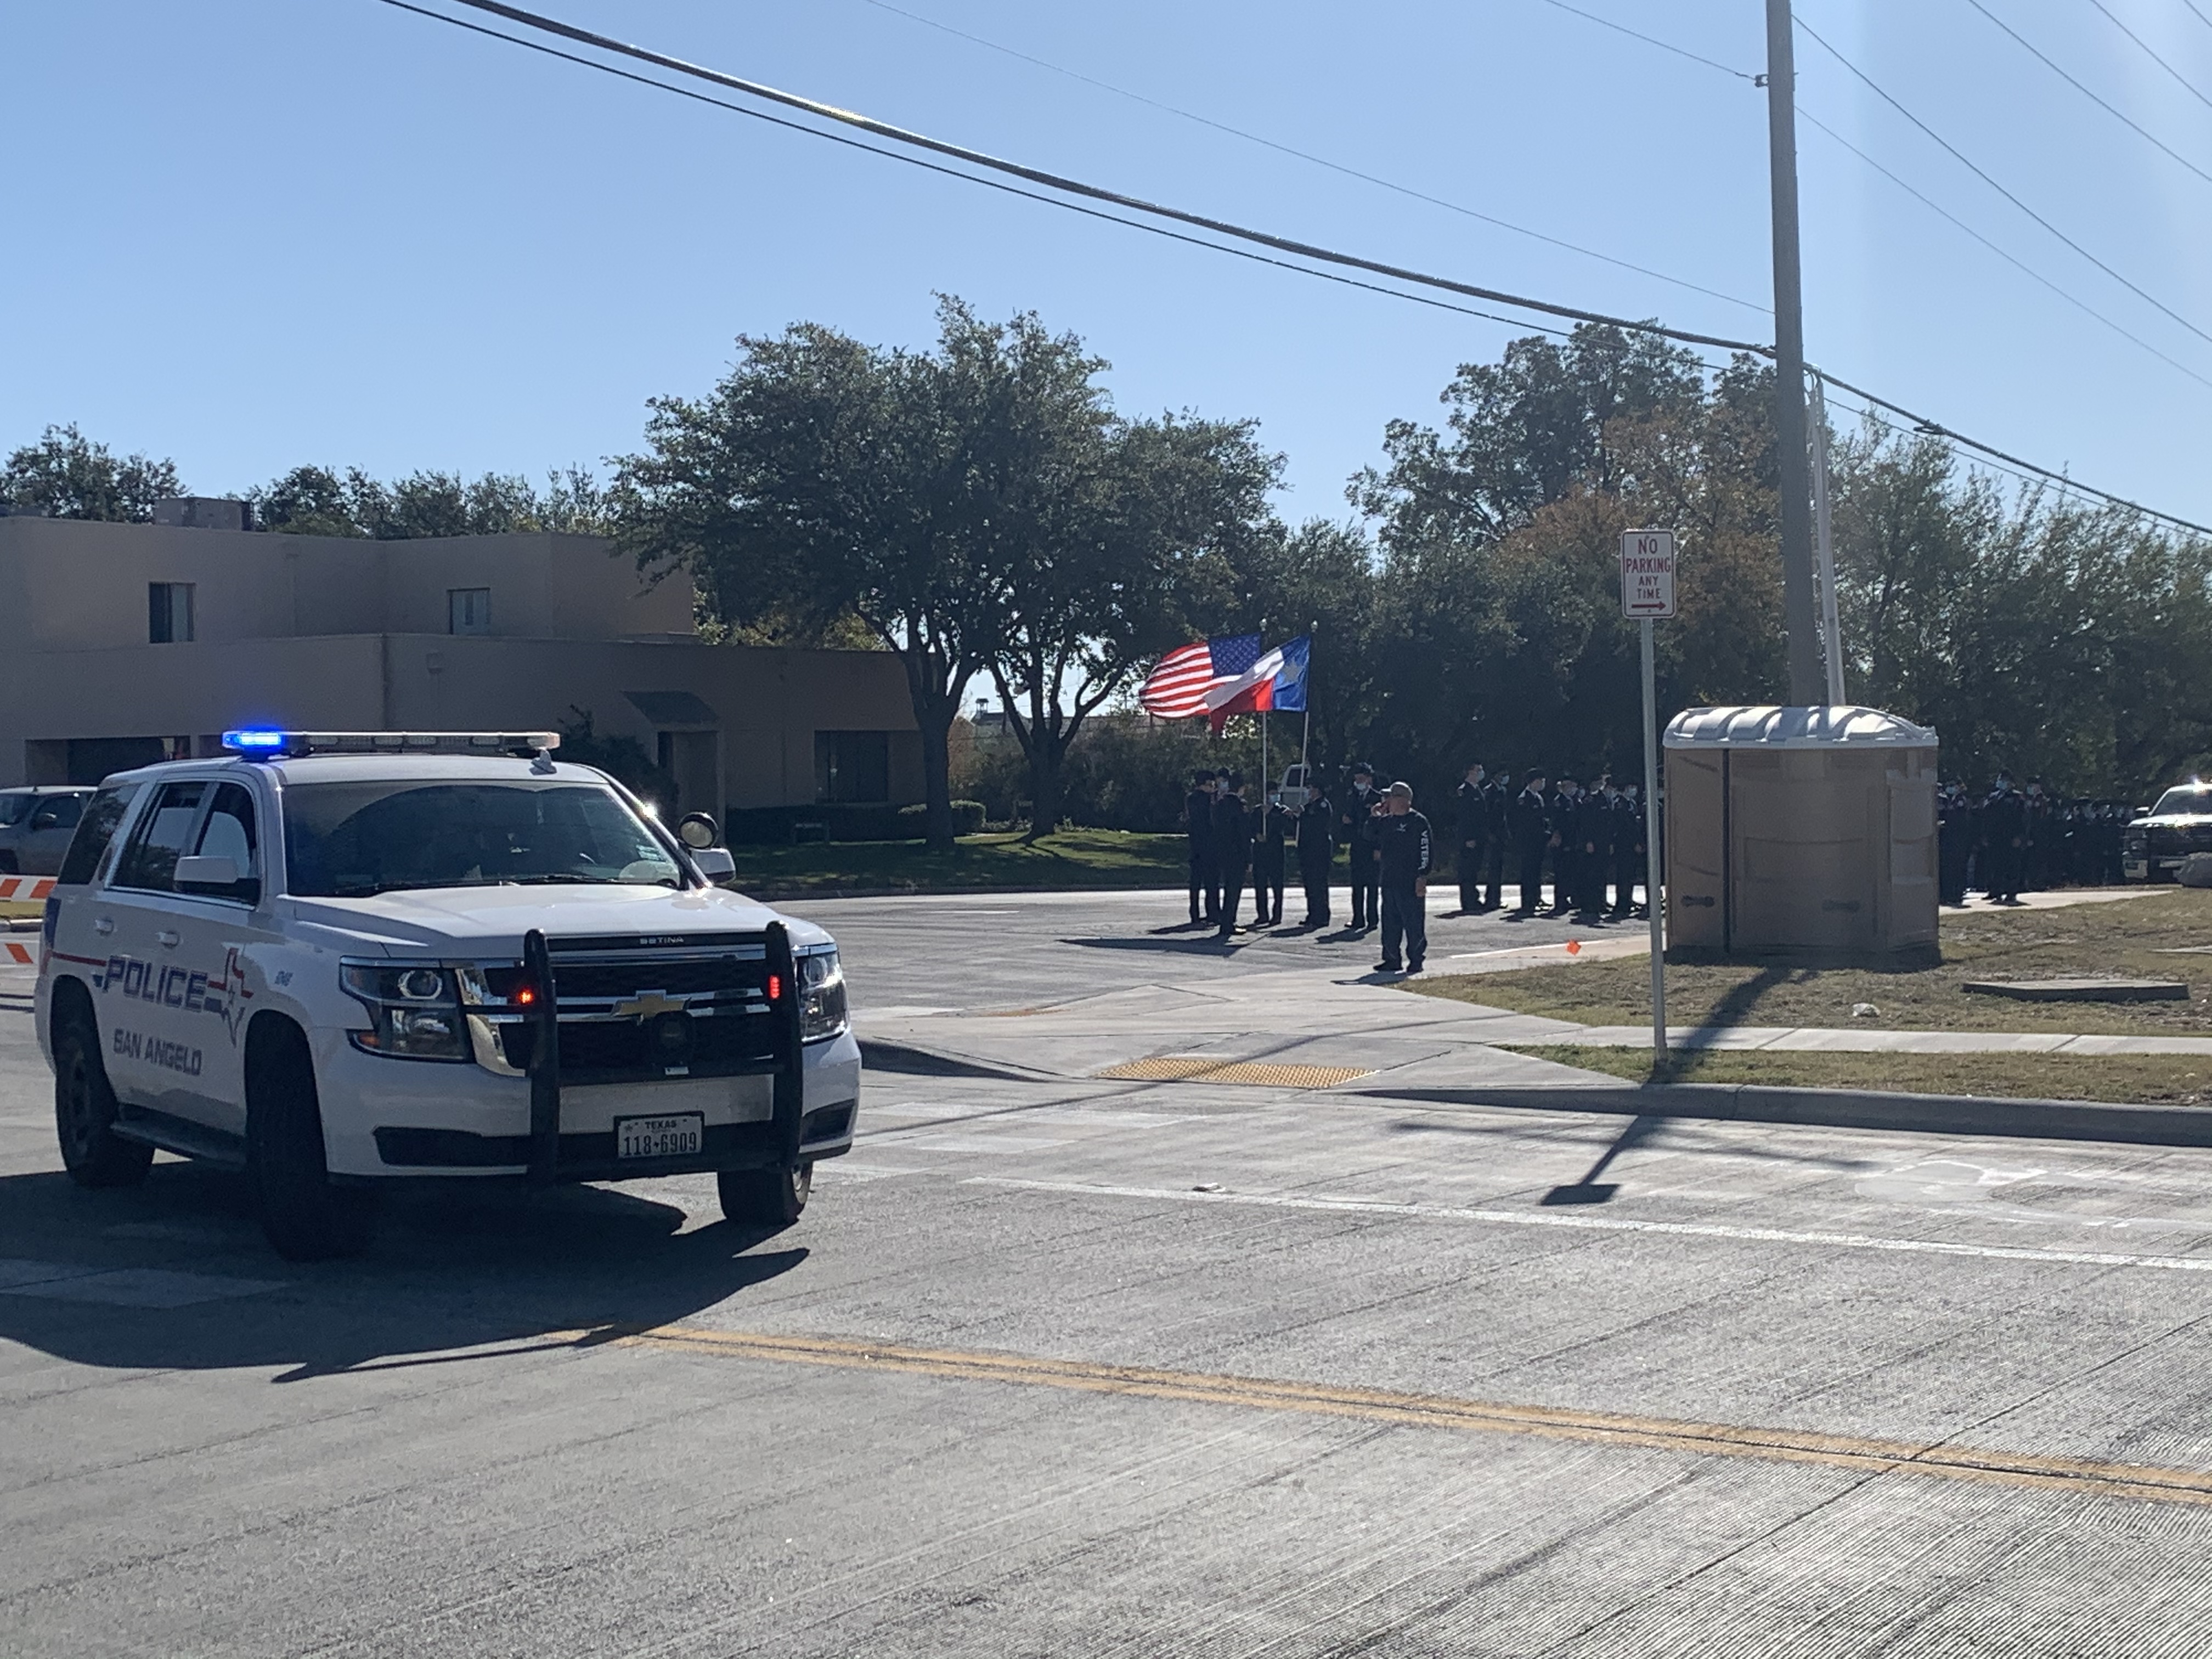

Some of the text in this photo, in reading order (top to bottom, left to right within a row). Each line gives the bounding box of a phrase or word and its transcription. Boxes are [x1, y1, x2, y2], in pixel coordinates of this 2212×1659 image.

[1638, 539, 1658, 555] NO
[1626, 557, 1671, 573] PARKING
[1639, 575, 1659, 586] ANY
[1637, 588, 1661, 599] TIME
[102, 955, 208, 1013] POLICE
[113, 1028, 202, 1076] SAN ANGELO
[645, 1120, 678, 1130] TEXAS
